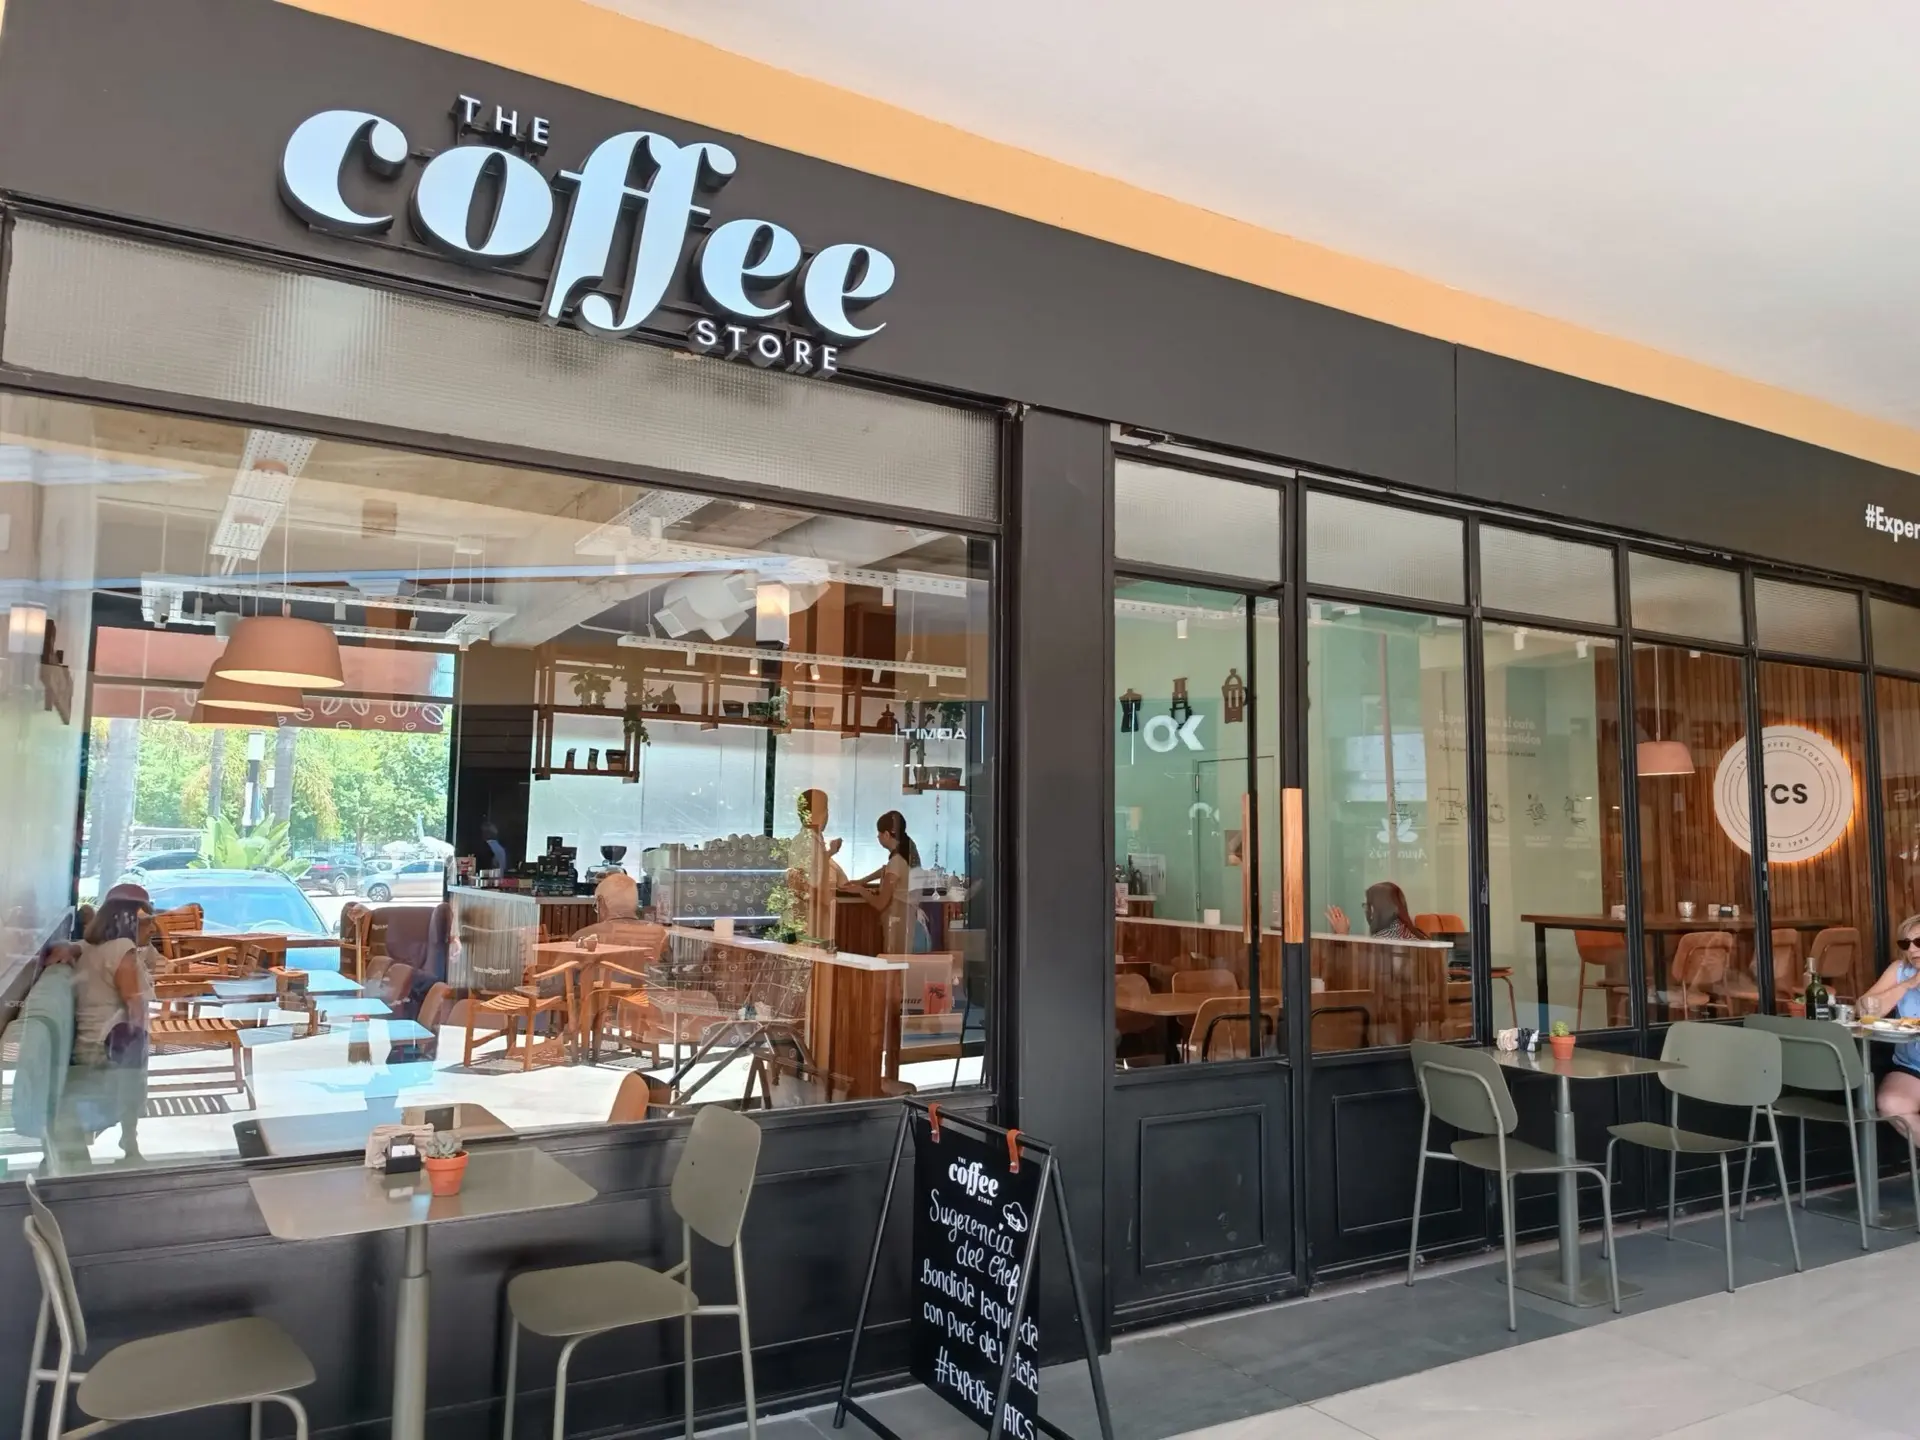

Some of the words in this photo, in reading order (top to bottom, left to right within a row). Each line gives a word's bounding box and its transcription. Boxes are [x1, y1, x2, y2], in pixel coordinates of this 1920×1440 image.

[459, 94, 549, 145] THE
[282, 109, 897, 337] coffee
[697, 319, 838, 371] STORE
[1865, 503, 1920, 542] #Exper
[948, 1161, 999, 1198] coffee
[929, 1188, 1015, 1258] Sugerencia
[956, 1240, 985, 1273] del
[923, 1301, 944, 1326] con
[979, 1330, 997, 1364] de
[980, 1290, 1038, 1351] laquda
